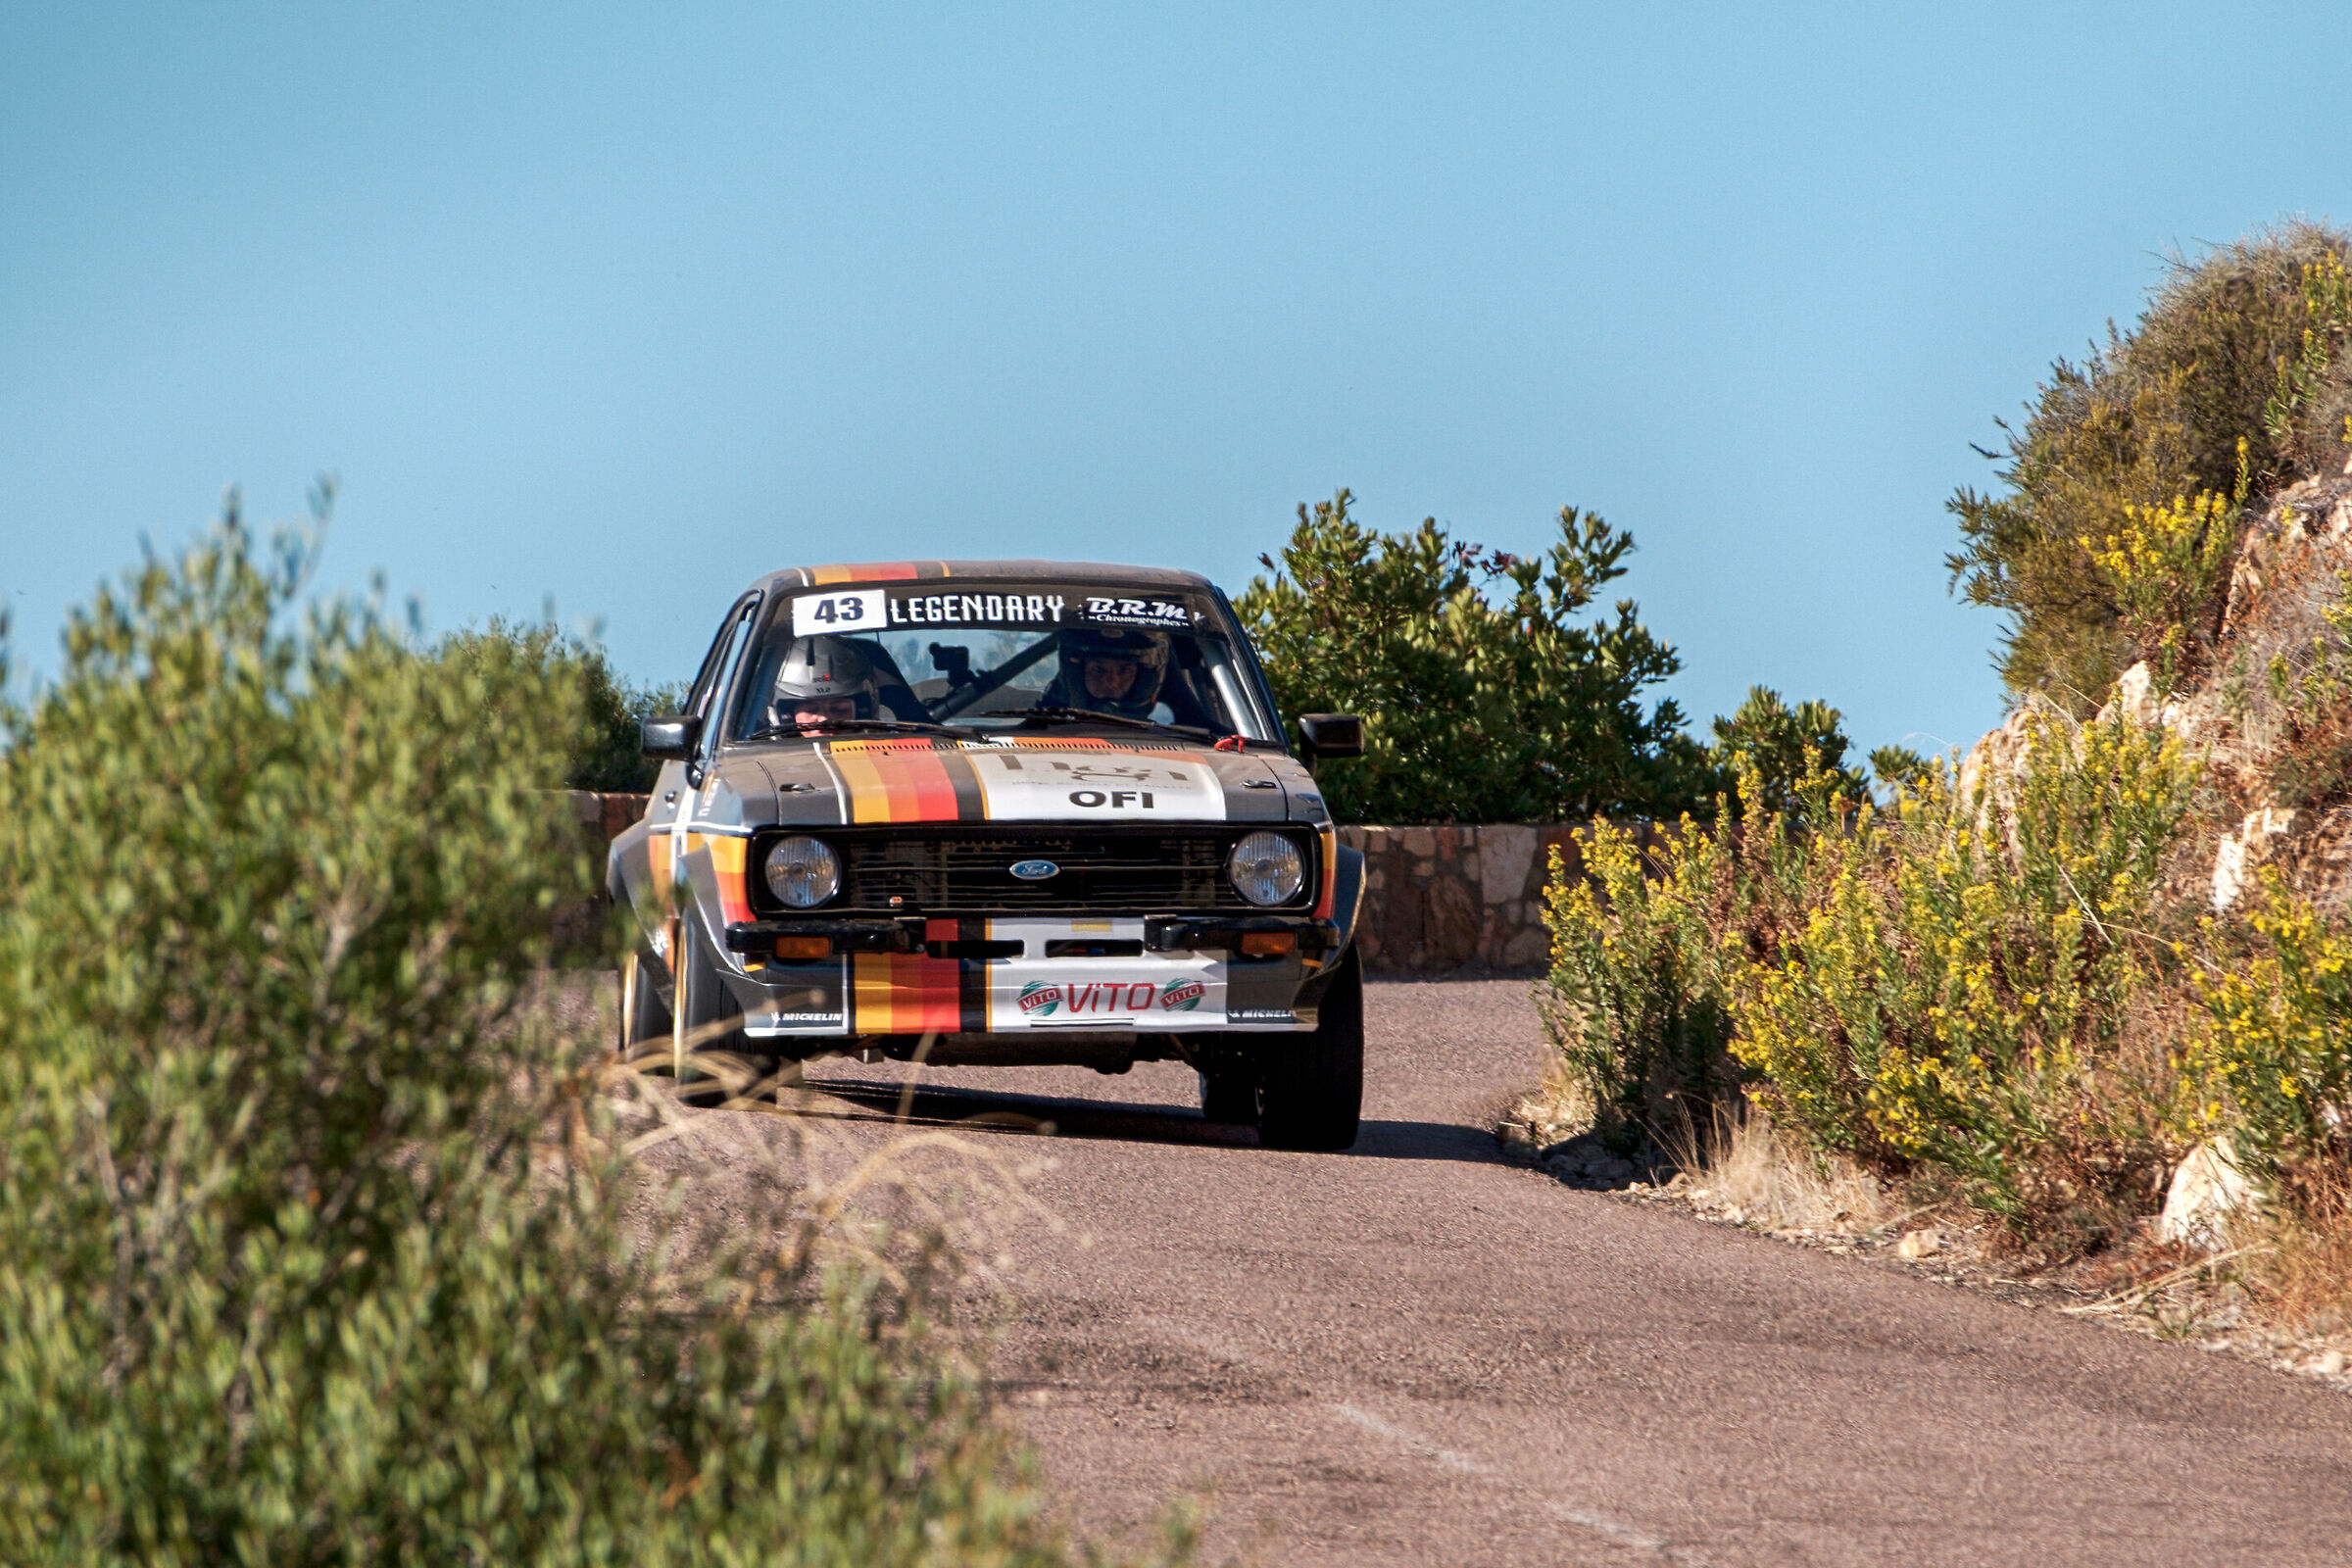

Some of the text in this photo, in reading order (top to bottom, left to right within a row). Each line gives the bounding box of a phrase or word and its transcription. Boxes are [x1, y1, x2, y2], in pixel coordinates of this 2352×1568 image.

[813, 596, 864, 624] 43
[890, 594, 1065, 623] LEGENDARY
[1069, 790, 1154, 809] OFI
[782, 1012, 843, 1021] MICHELIN
